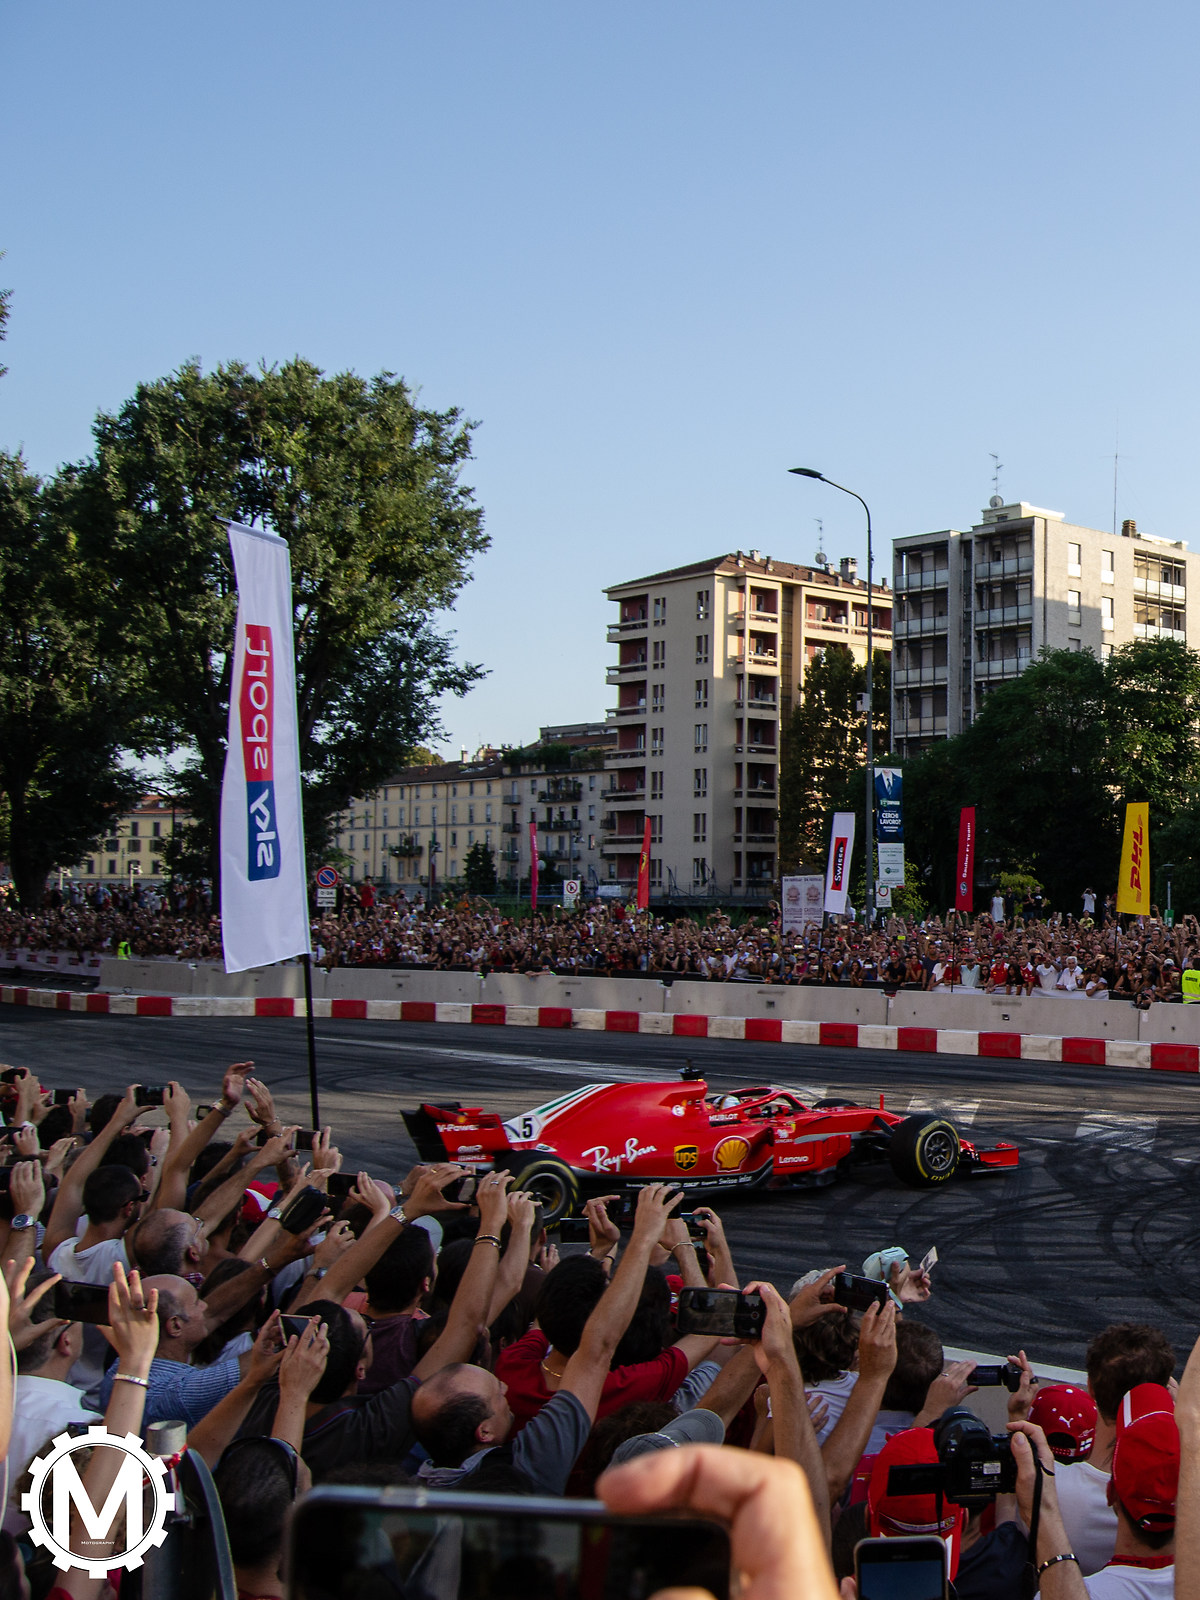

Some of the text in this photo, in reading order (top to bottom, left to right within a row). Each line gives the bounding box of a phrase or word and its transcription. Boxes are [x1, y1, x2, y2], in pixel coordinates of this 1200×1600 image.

[1130, 826, 1143, 890] DHL
[708, 1113, 739, 1121] HUBLOT
[521, 1117, 533, 1139] 5
[581, 1137, 657, 1173] Ray-Ban
[675, 1151, 698, 1166] ups
[778, 1156, 809, 1164] Lenovo
